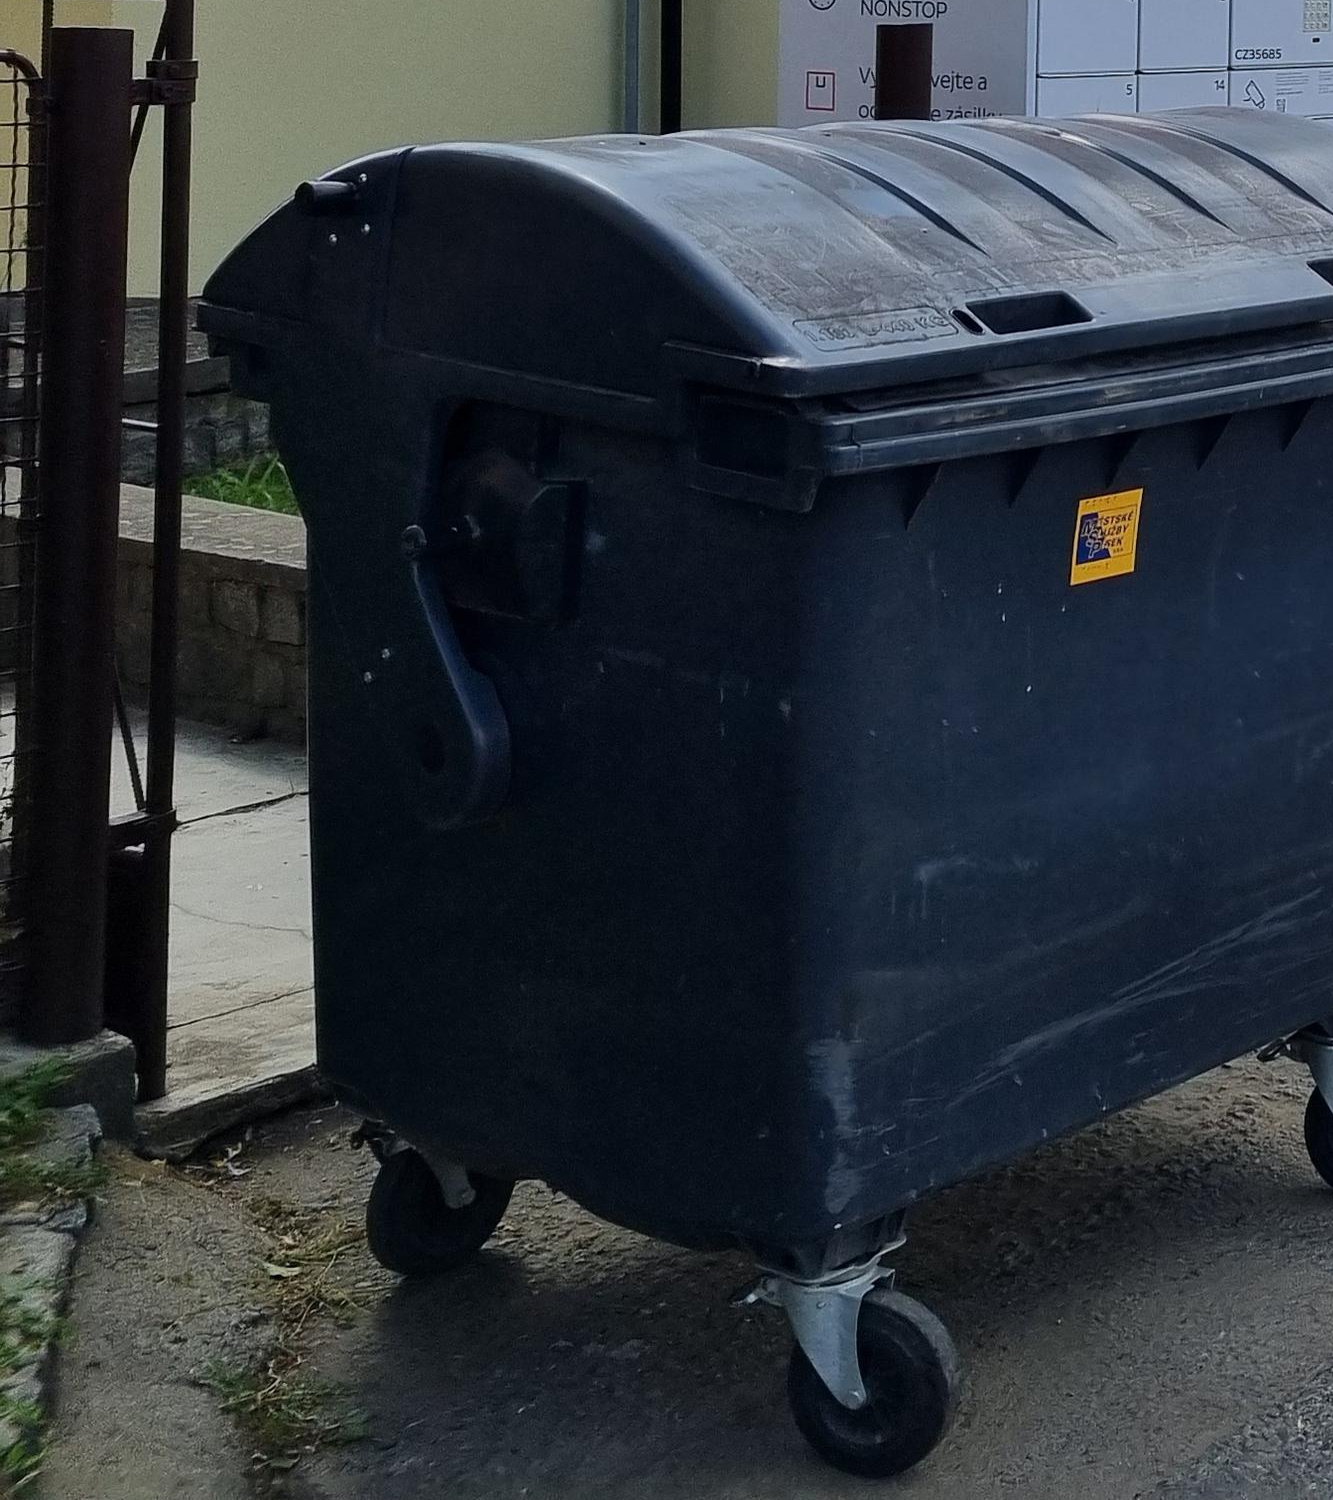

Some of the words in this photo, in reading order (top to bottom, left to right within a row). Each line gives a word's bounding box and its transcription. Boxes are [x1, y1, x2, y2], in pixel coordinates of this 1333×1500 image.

[860, 0, 948, 19] NONSTOP
[1234, 49, 1282, 60] CZ35685
[978, 76, 988, 90] a
[1214, 80, 1225, 91] 14
[1125, 84, 1133, 96] 5
